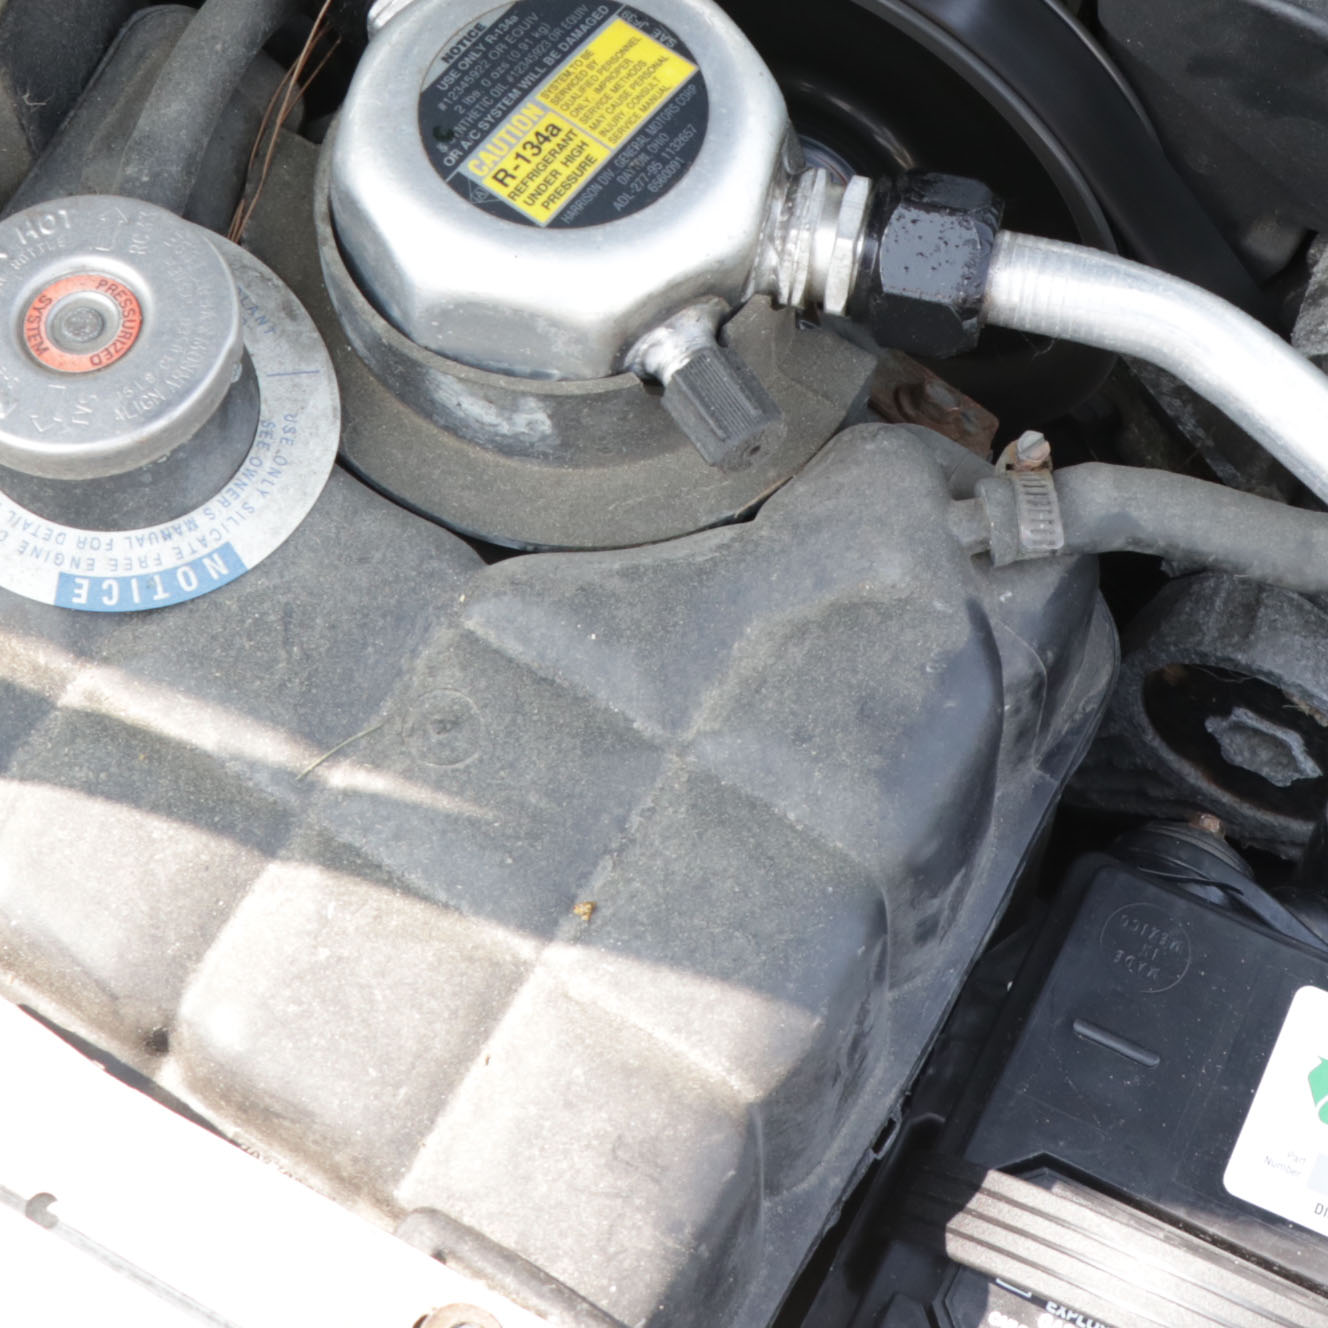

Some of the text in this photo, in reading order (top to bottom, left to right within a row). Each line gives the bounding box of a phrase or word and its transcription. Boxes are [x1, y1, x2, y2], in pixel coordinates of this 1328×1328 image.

[435, 69, 461, 90] USE
[456, 43, 488, 69] ONLY
[440, 23, 487, 62] NOTICE
[487, 43, 507, 60] OR
[489, 81, 509, 97] OIL
[547, 28, 563, 40] OR
[441, 148, 464, 167] OR
[476, 89, 523, 130] SYSTEM
[518, 65, 546, 90] WILL
[542, 50, 561, 65] BE
[557, 4, 611, 51] DAMAGED
[540, 49, 593, 99] SYSTEM TO BE
[550, 60, 599, 105] SERVICED BY
[559, 35, 641, 111] QUALIFIED PERSONNEL
[579, 59, 647, 124] SERVICE METHODS
[588, 54, 668, 130] MAY CAUSE PERSONAL
[593, 58, 633, 94] IMPROPER
[625, 76, 661, 109] CONSULT
[453, 104, 466, 113] 2
[608, 84, 669, 143] SERVICE MANUAL
[464, 102, 547, 177] CAUTION
[490, 120, 564, 187] R-134a
[559, 181, 603, 223] HARRISON
[612, 133, 650, 168] GENERAL
[644, 102, 681, 136] MOTORS
[645, 131, 671, 154] OHIO
[505, 129, 580, 200] REFRIGERANT
[522, 140, 590, 206] UNDER HIGH
[539, 154, 597, 210] PRESSURE
[14, 209, 72, 246] HOT
[27, 294, 53, 356] SYSTEM
[89, 279, 144, 367] PRESSURIZED
[256, 420, 274, 452] SEE
[279, 411, 298, 448] USE
[258, 454, 289, 500] ONLY
[10, 510, 68, 545] DETAIL
[77, 536, 114, 552] FOR
[125, 515, 200, 549] MANUAL
[172, 501, 256, 561] SILICATE
[18, 541, 96, 572] ENGINE
[110, 551, 163, 572] FREE
[71, 555, 229, 607] NOTICE
